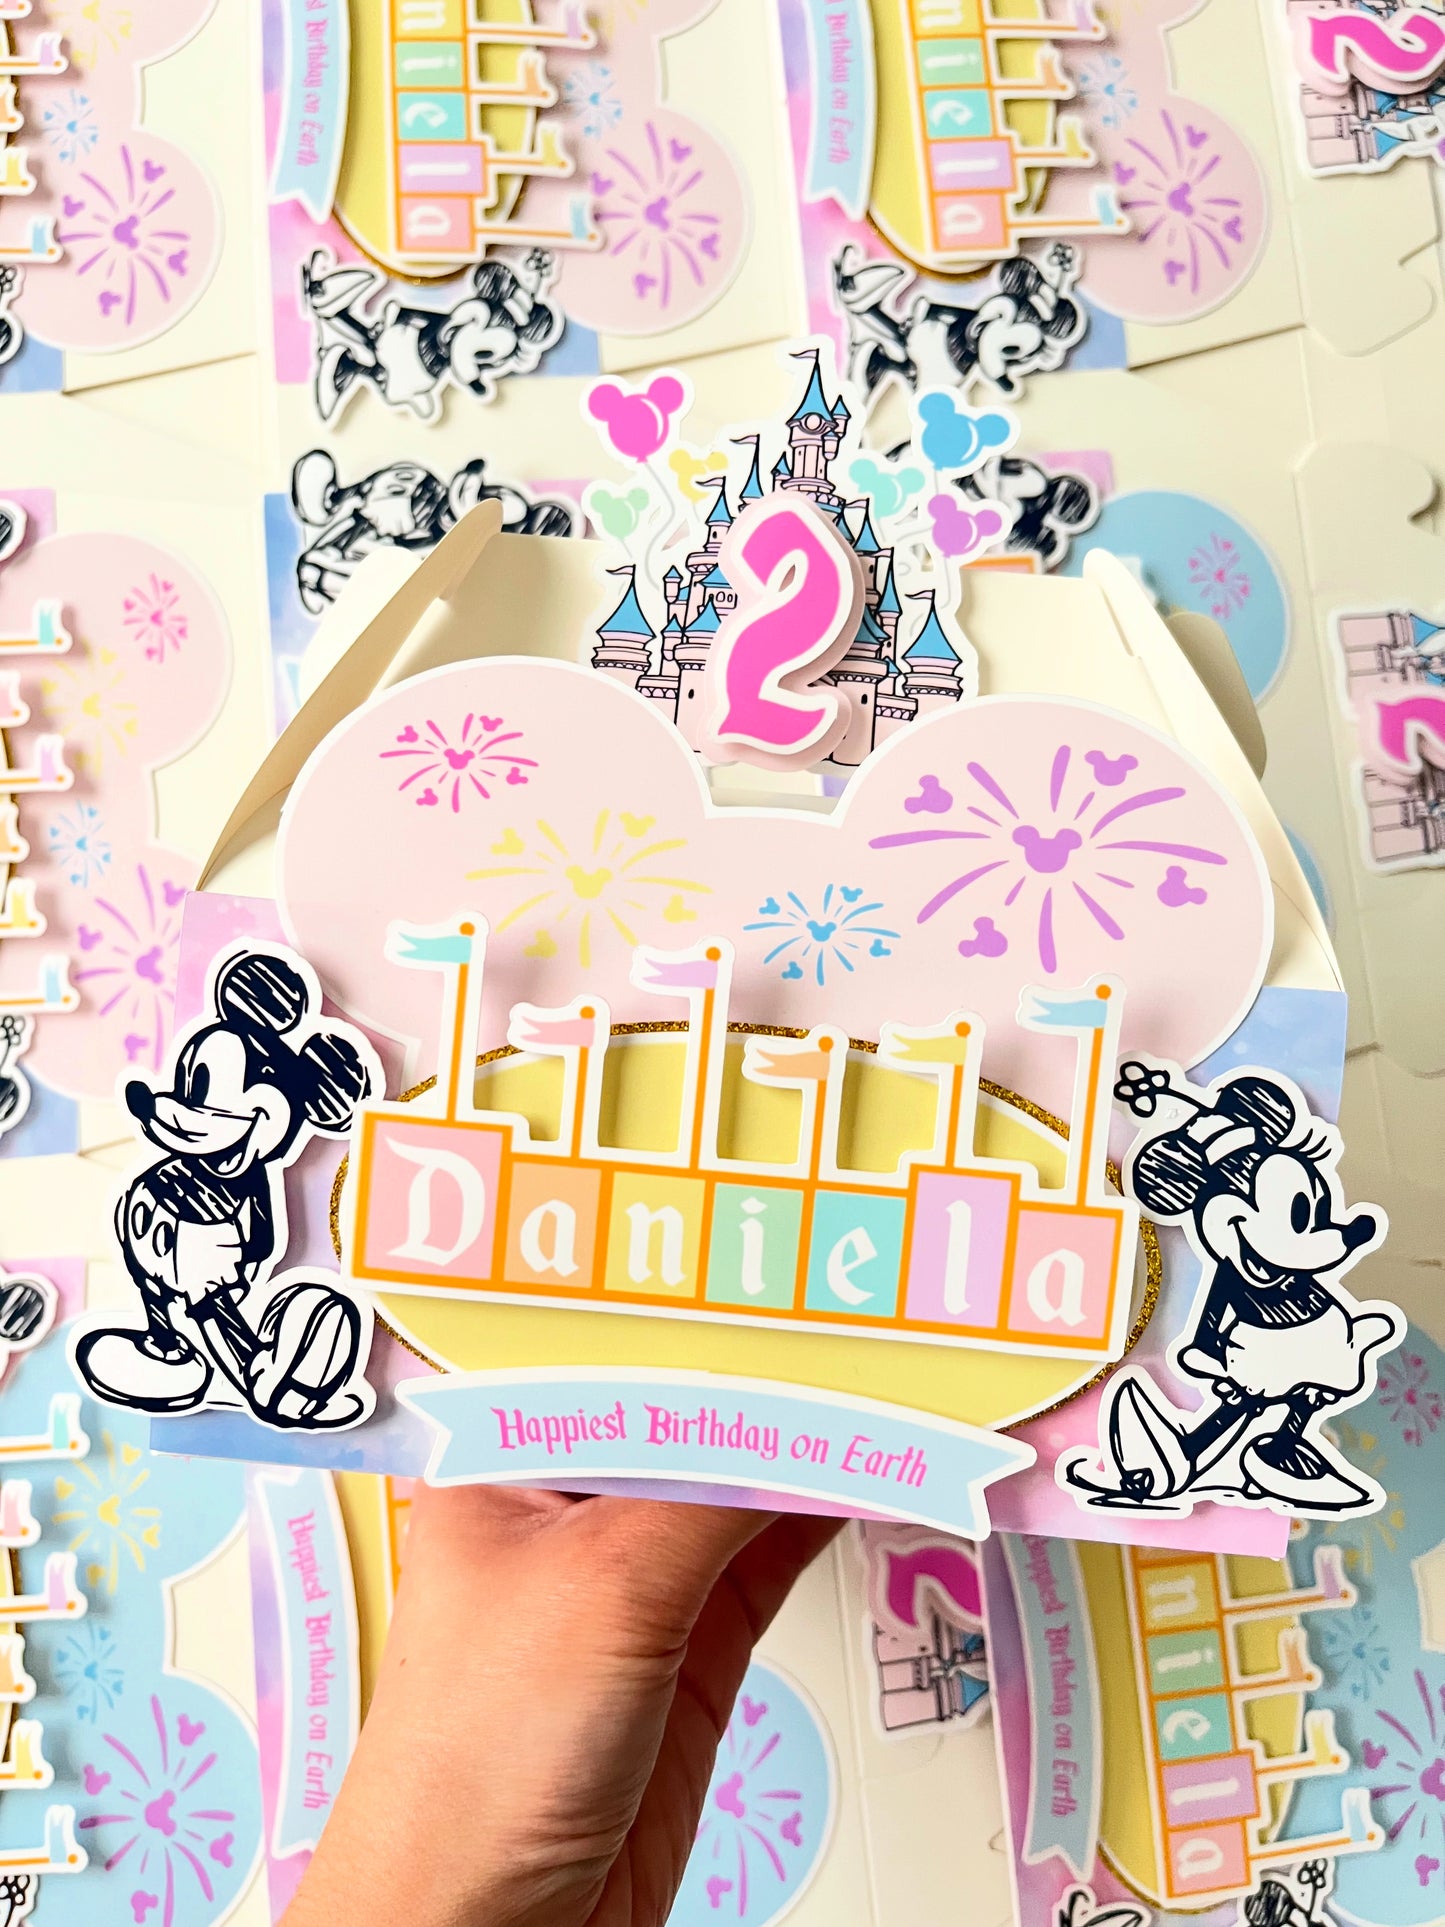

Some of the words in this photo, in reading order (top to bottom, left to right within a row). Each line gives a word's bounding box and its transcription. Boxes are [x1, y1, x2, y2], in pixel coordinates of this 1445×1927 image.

[1308, 14, 1445, 74] 2
[400, 0, 471, 240] niela
[919, 0, 1000, 238] niela
[717, 510, 842, 746] 2
[384, 1135, 1088, 1327] Daniela
[489, 1400, 628, 1455] Happiest
[643, 1401, 780, 1461] Birthday
[789, 1433, 830, 1465] on
[839, 1434, 929, 1488] Earth
[286, 1509, 331, 1603] Happiest
[304, 1611, 336, 1708] Birthday
[1044, 1621, 1078, 1717] Birthday
[308, 1713, 328, 1742] on
[1052, 1722, 1074, 1750] on
[1149, 1575, 1240, 1880] niela
[303, 1750, 333, 1810] Earth
